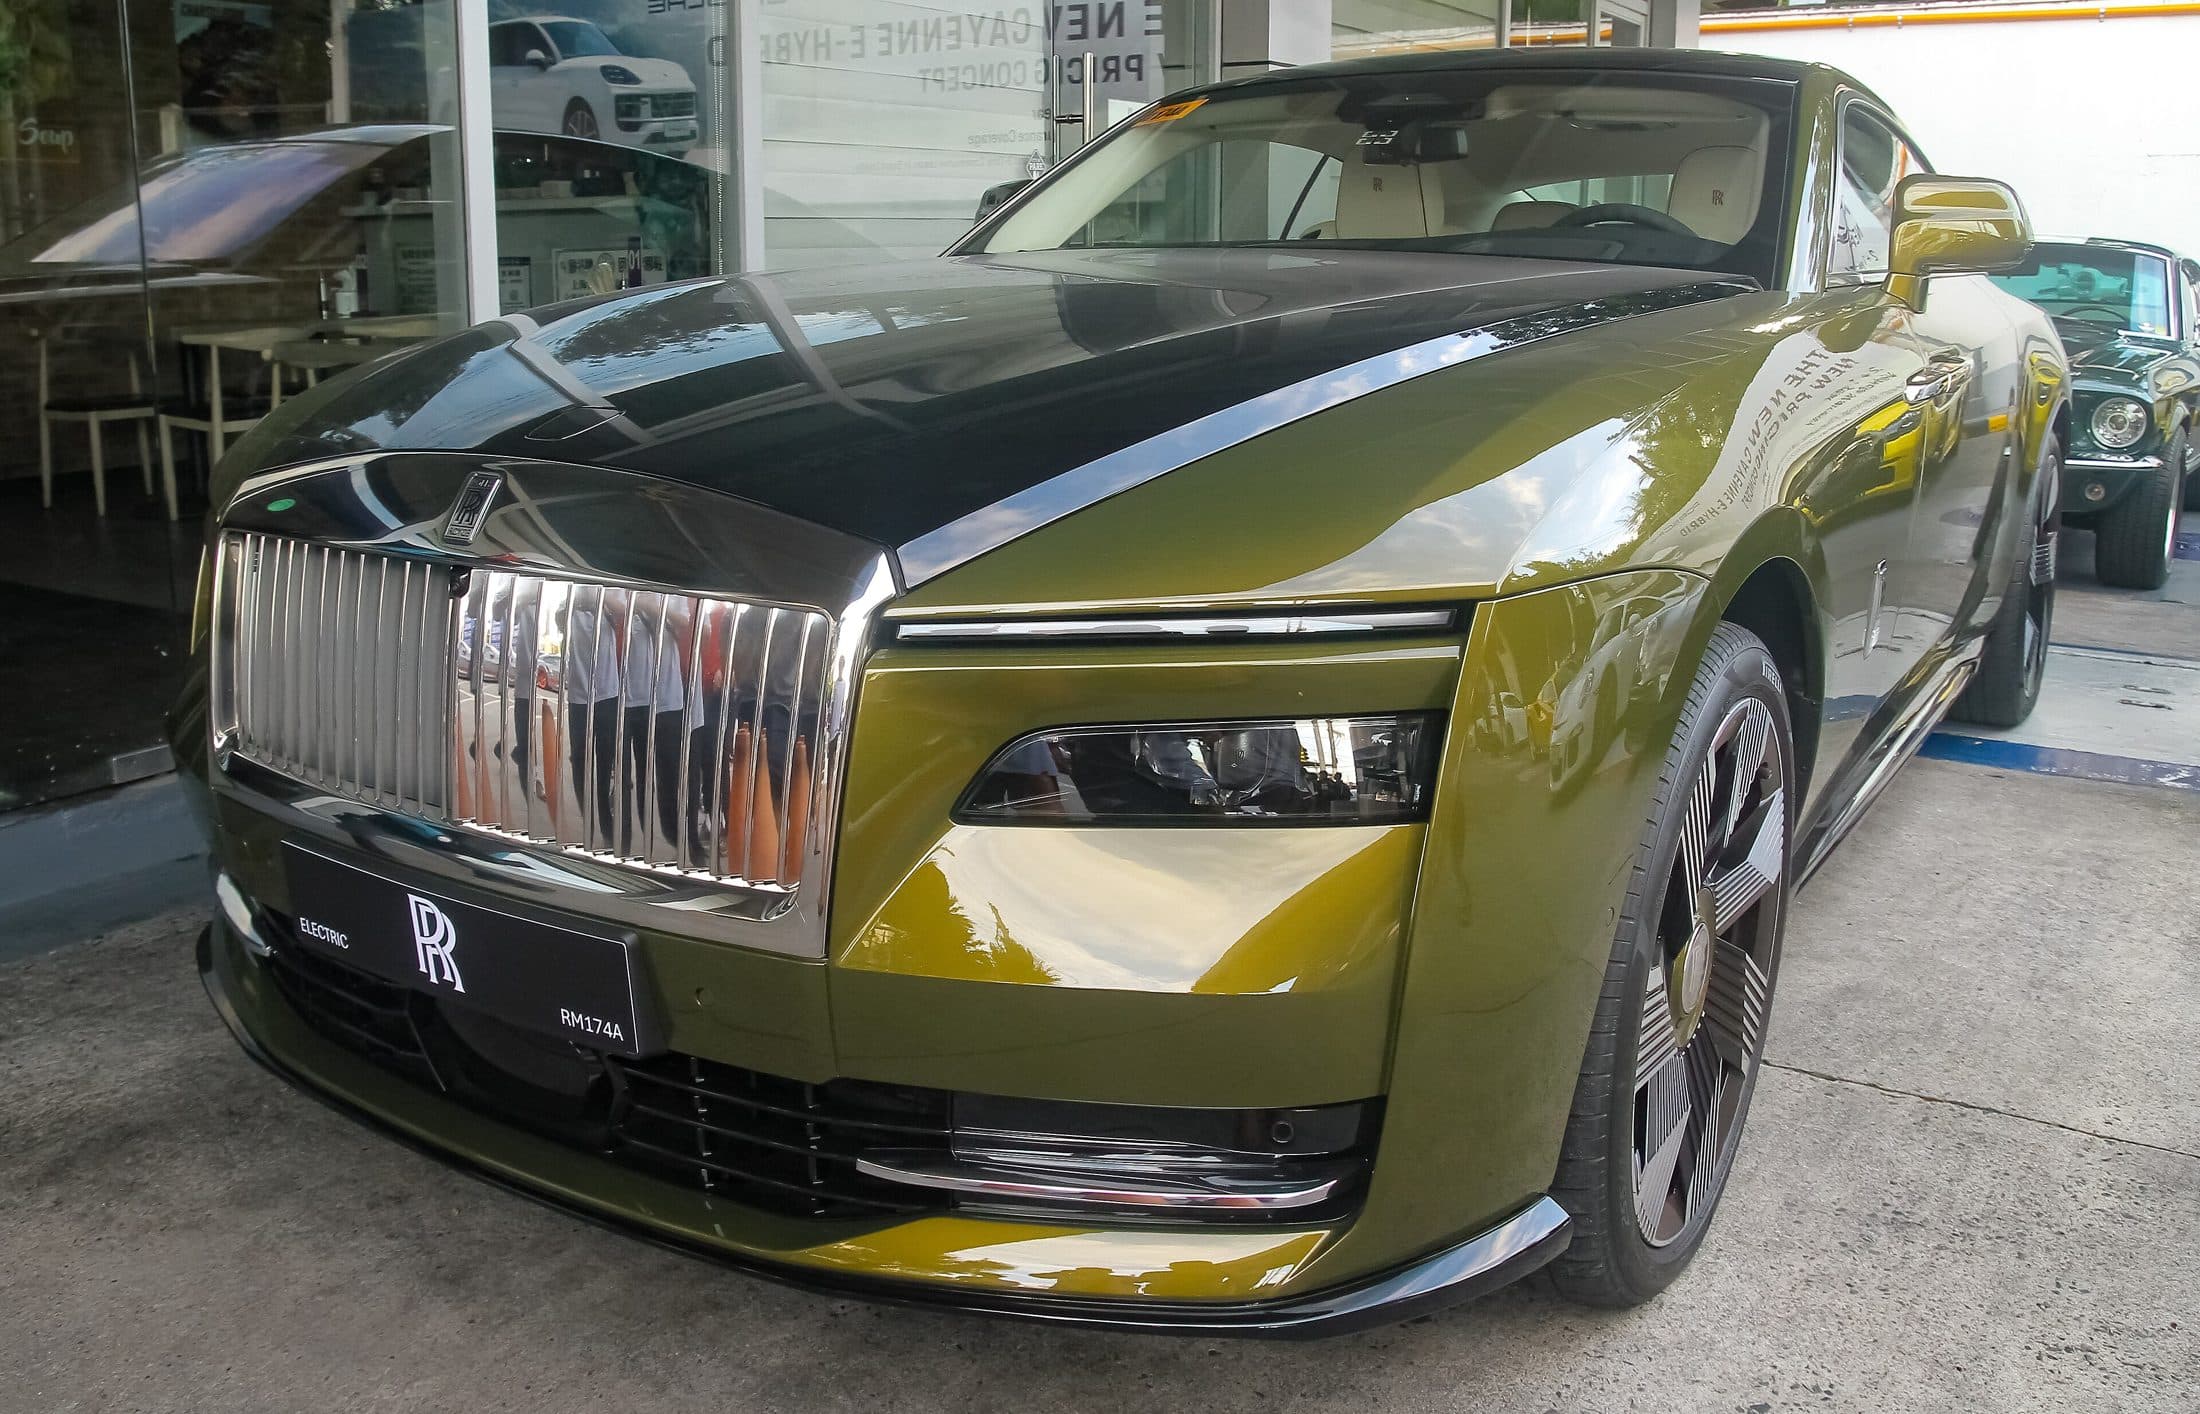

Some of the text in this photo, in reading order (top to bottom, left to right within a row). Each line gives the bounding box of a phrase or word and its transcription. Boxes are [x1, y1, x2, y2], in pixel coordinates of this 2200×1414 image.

[629, 250, 641, 269] 01
[300, 917, 350, 949] ELECTRIC
[408, 893, 466, 993] RR
[560, 1008, 624, 1042] RM174A
